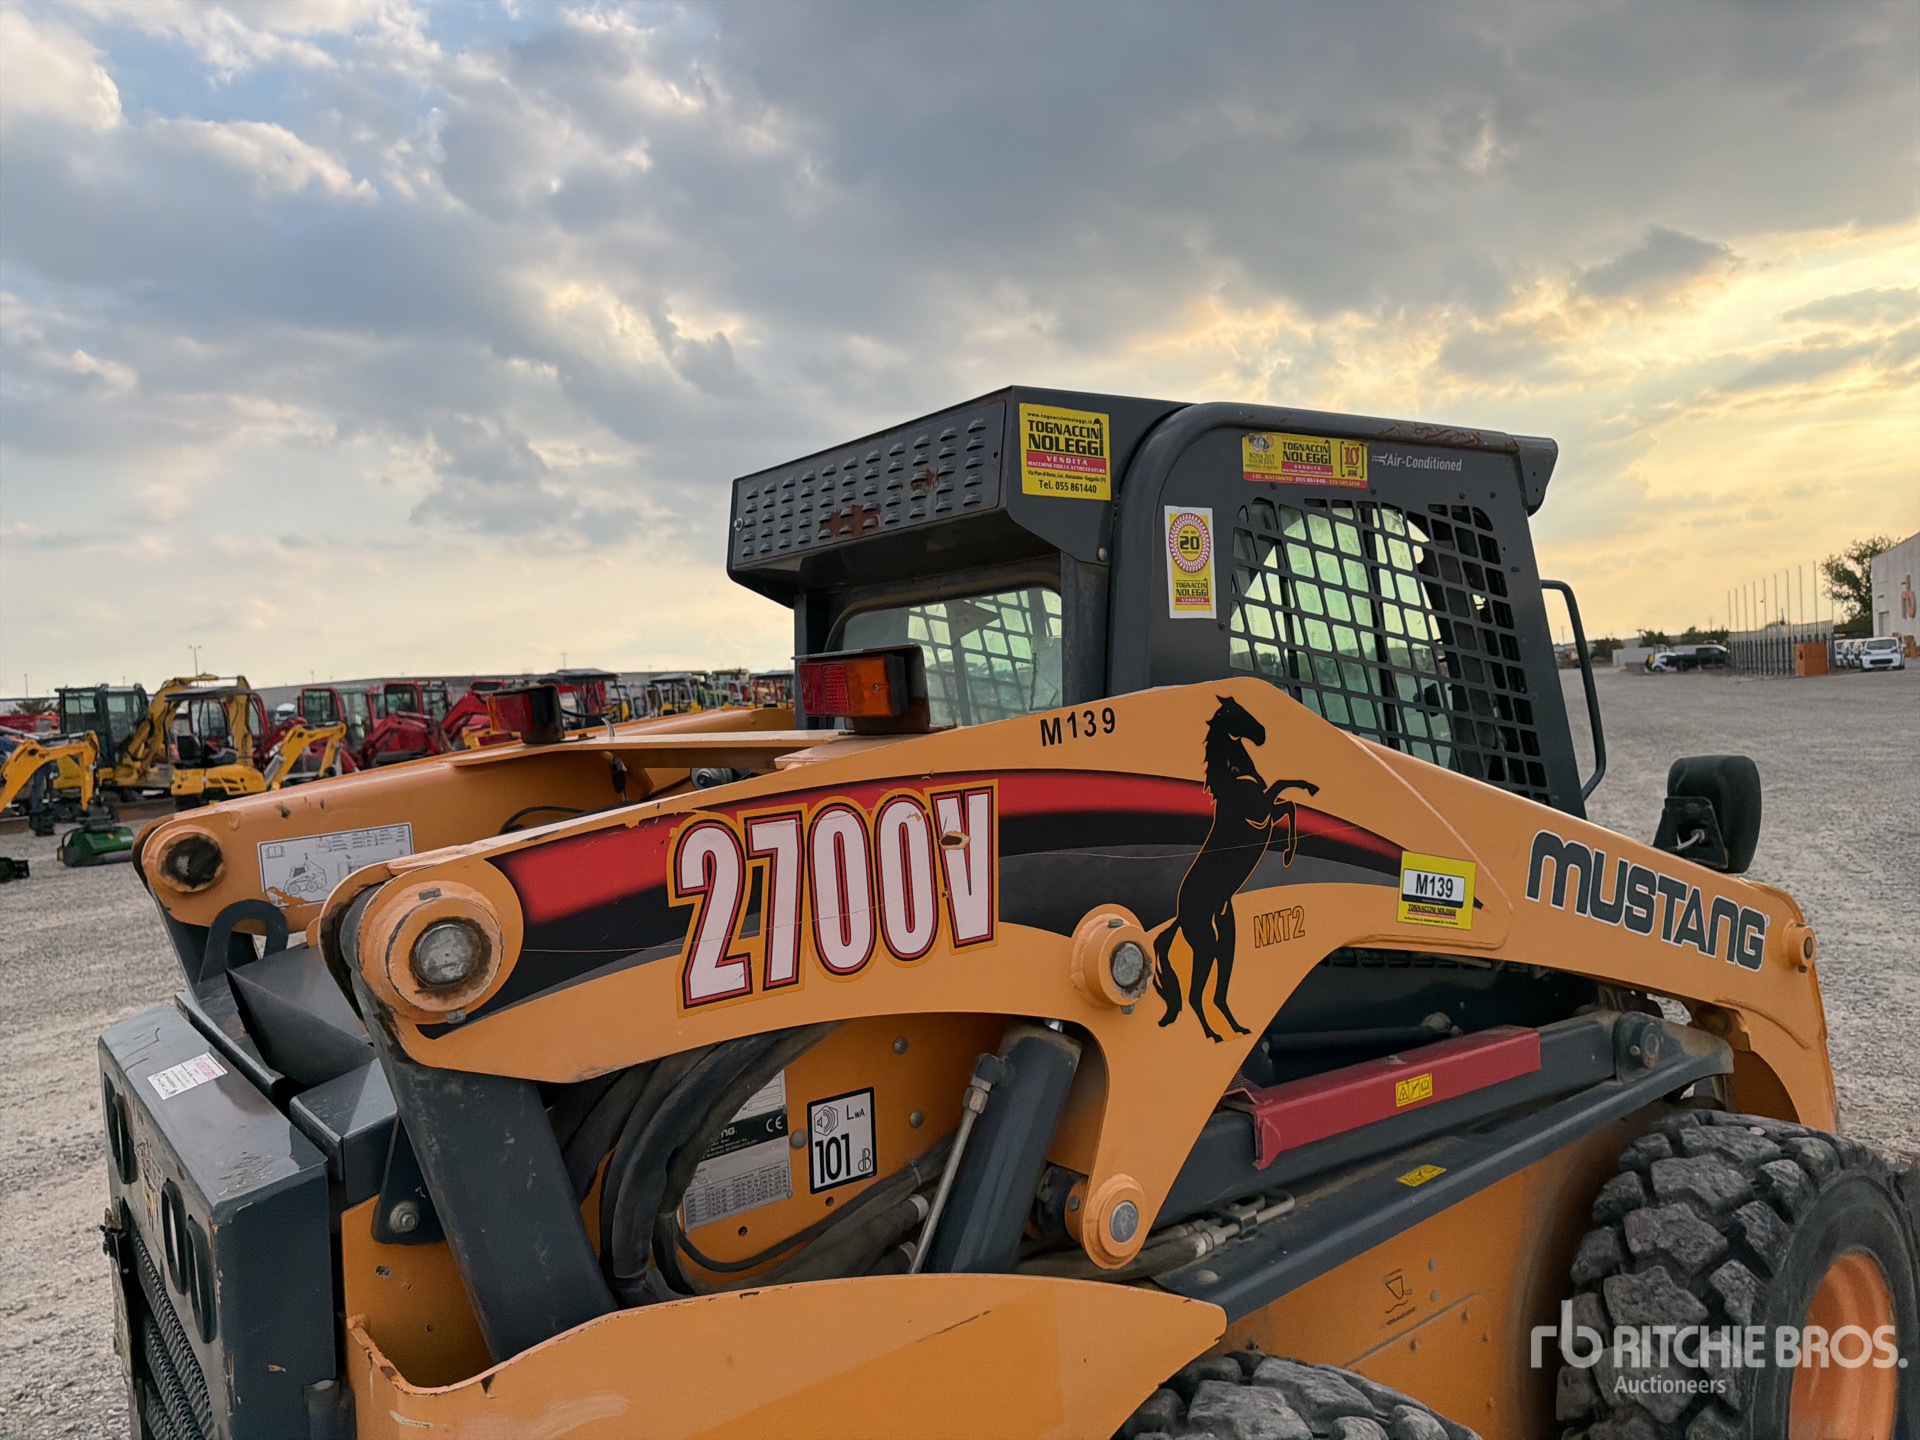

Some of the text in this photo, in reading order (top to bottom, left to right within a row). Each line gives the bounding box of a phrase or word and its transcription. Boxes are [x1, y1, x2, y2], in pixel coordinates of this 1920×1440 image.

[1028, 433, 1104, 457] NOLEGGI
[1046, 455, 1088, 466] VENDITA
[1387, 453, 1463, 472] Air-Conditioned
[1038, 479, 1097, 494] Tel. 055 861440
[1040, 707, 1116, 747] M139
[672, 783, 996, 1011] 2700V
[1415, 873, 1454, 898] M139
[1525, 829, 1766, 972] MUSTANG
[1253, 905, 1306, 949] NXT2
[765, 1115, 783, 1133] CE
[815, 1133, 851, 1184] 101
[858, 1148, 872, 1172] dB
